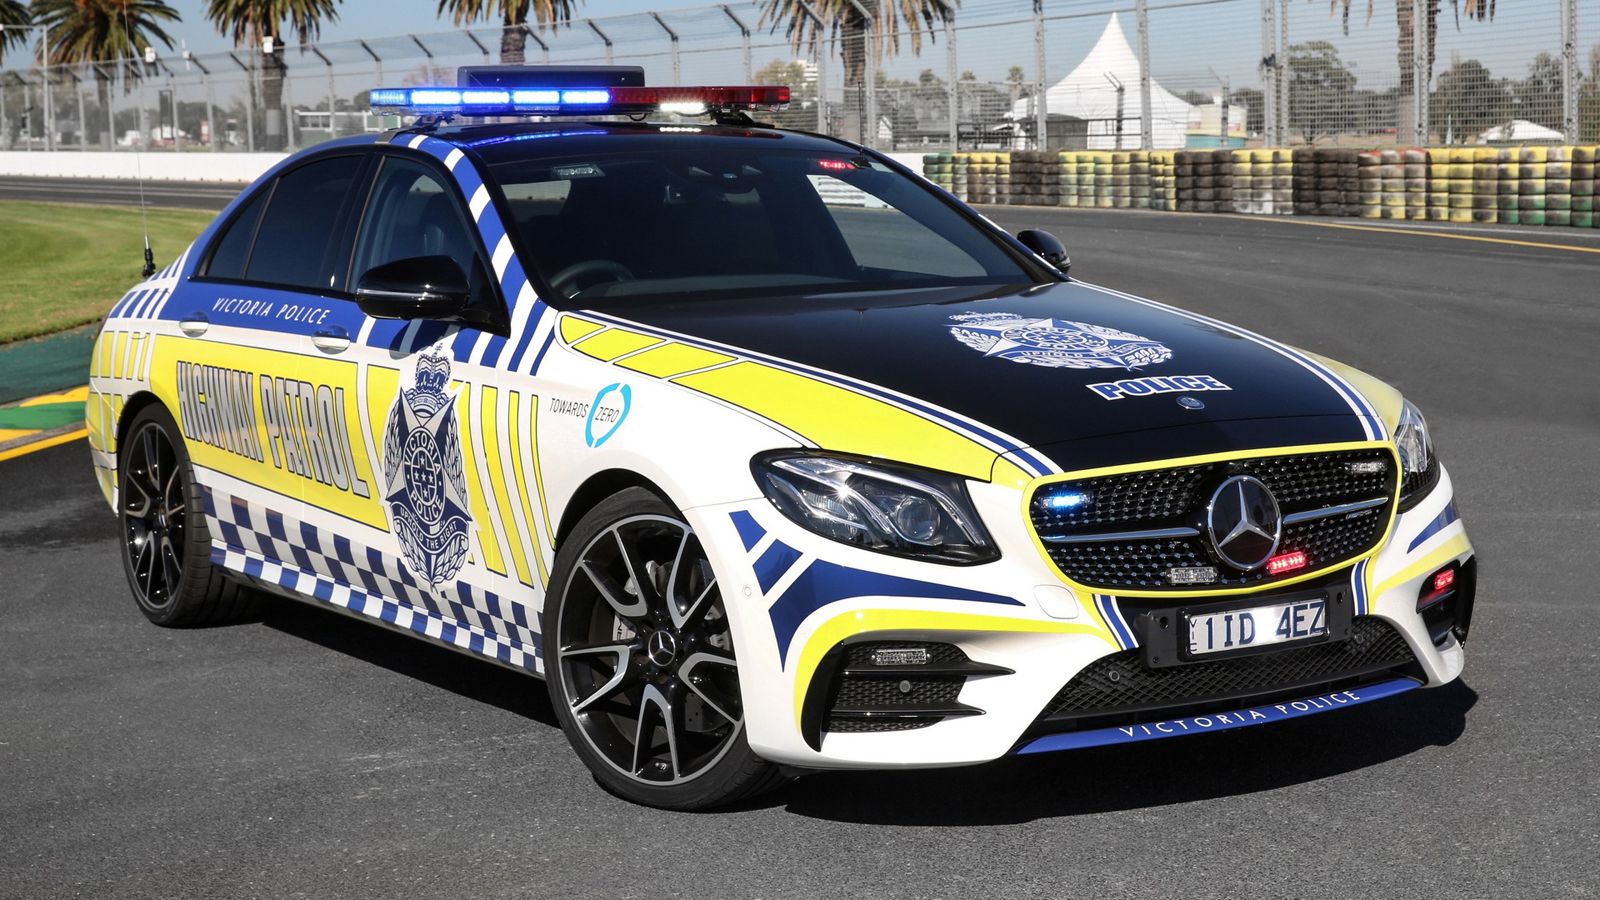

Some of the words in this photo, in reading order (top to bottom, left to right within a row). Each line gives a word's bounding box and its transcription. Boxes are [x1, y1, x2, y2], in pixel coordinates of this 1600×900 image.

[212, 297, 274, 317] VICTORIA
[276, 304, 331, 325] POLICE
[1085, 375, 1233, 401] POLICE
[176, 360, 264, 463] HIGHWAY
[260, 374, 371, 499] PATROL
[549, 398, 589, 418] TOWARDS
[595, 406, 620, 423] ZERO
[405, 432, 441, 475] VICTORIA
[410, 490, 443, 521] POLICE
[400, 507, 424, 542] UPHOLD
[426, 539, 439, 549] THE
[440, 521, 457, 544] RIGHT
[1205, 612, 1256, 649] 1ID
[1275, 601, 1328, 638] 4EZ
[1119, 709, 1266, 737] VICTORIA
[1275, 690, 1361, 714] POLICE
